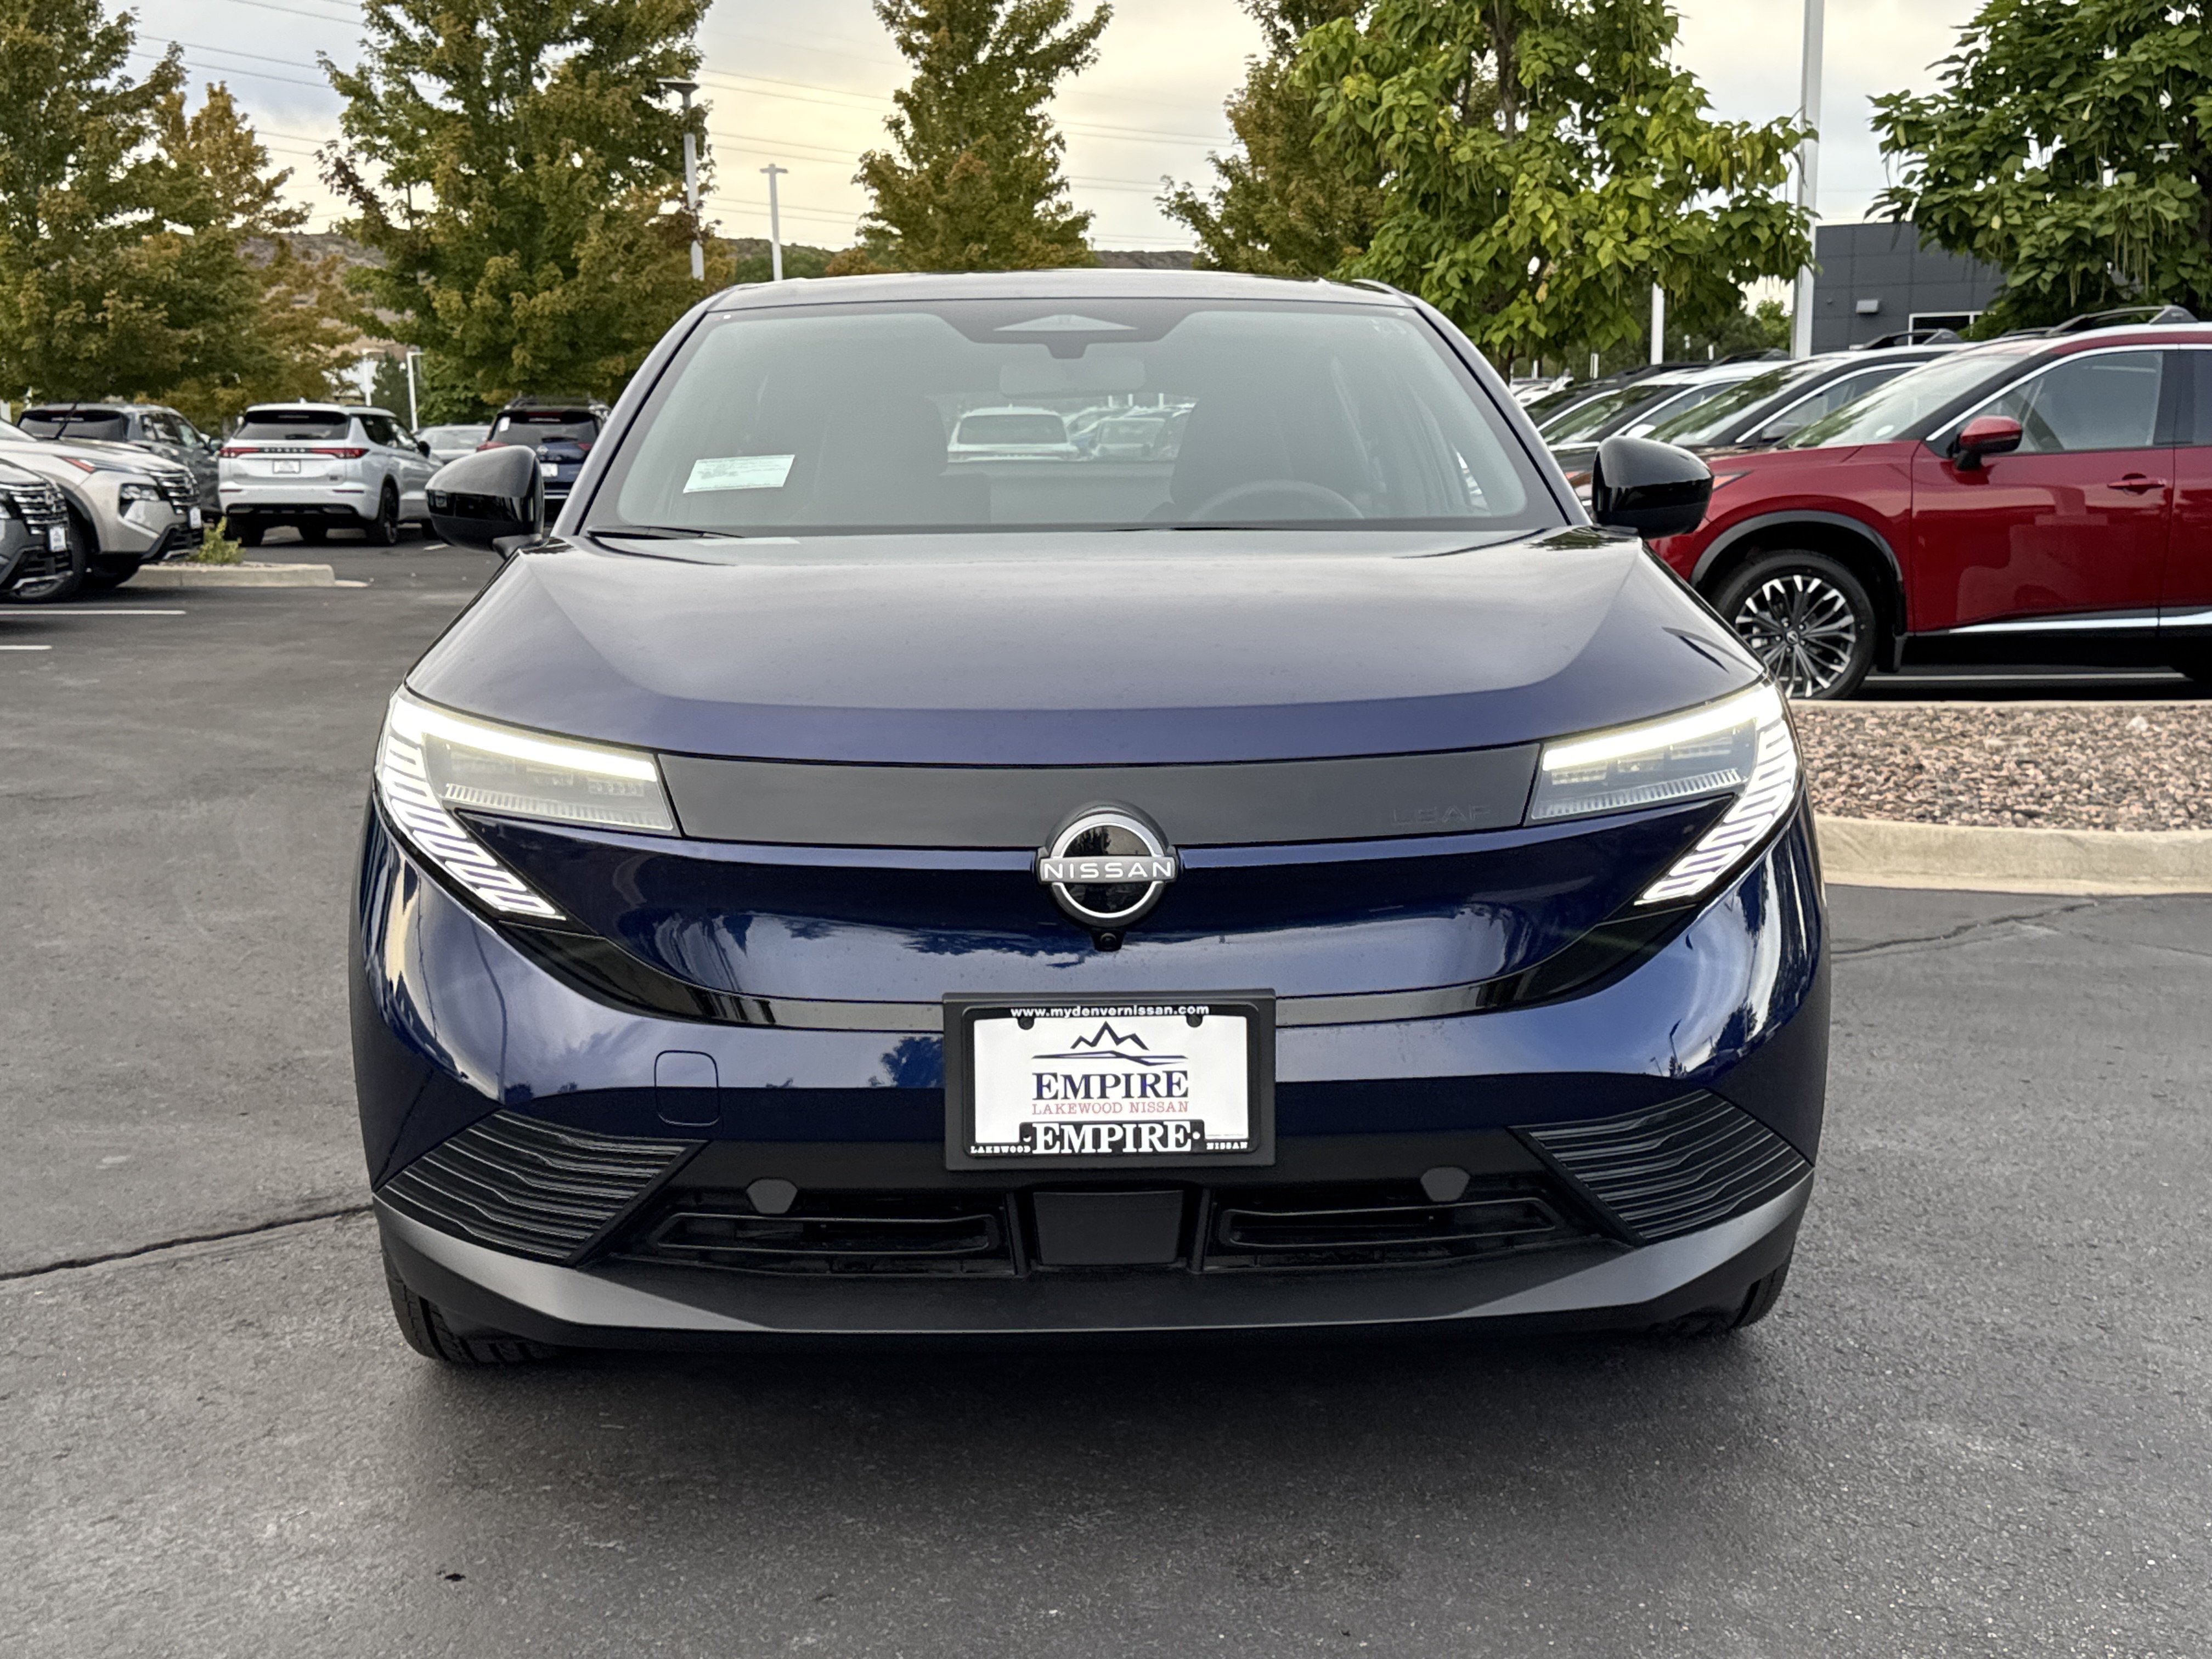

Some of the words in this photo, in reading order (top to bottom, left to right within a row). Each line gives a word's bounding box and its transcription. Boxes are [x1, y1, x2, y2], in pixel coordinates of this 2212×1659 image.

[1393, 804, 1491, 825] LEAF
[1044, 861, 1171, 879] NISSAN
[1010, 1005, 1209, 1018] www.mydenvernissan.com
[1031, 1070, 1188, 1100] EMPIRE
[1031, 1102, 1122, 1115] LAKEWOOD
[1128, 1101, 1189, 1114] NISSAN
[1032, 1121, 1192, 1154] EMPIRE
